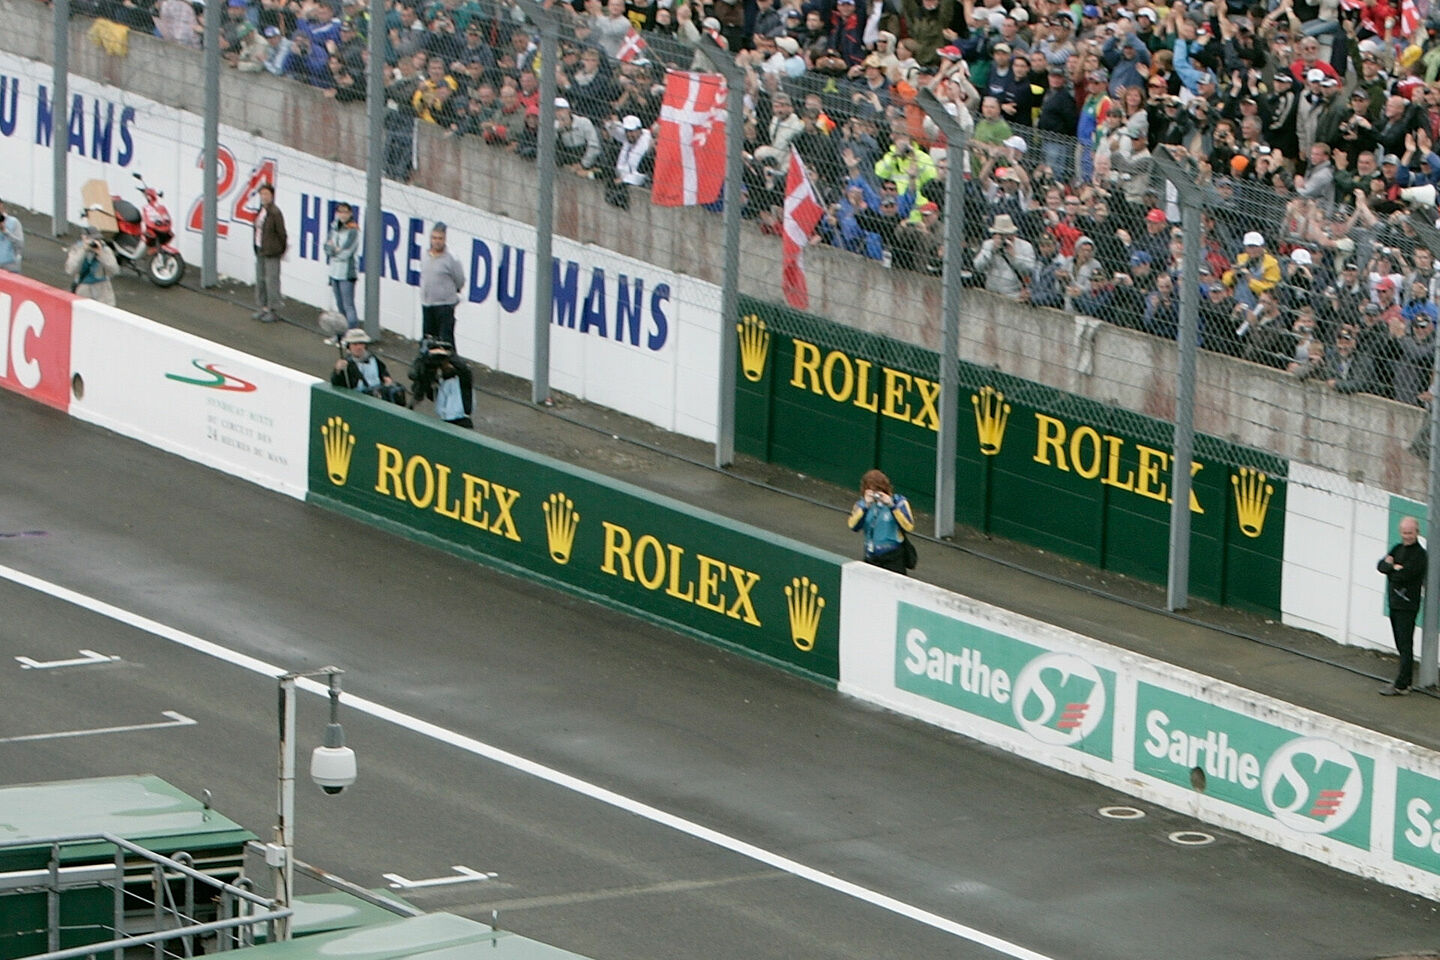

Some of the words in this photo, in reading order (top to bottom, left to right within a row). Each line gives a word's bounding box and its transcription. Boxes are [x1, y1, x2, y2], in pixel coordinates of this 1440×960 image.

[469, 238, 525, 313] DU
[552, 256, 671, 351] MANS
[789, 339, 941, 431] ROLEX
[375, 443, 521, 542] ROLEX
[601, 521, 762, 628] ROLEX
[904, 628, 1011, 705] Sarthe
[1143, 709, 1261, 790] Sarthe
